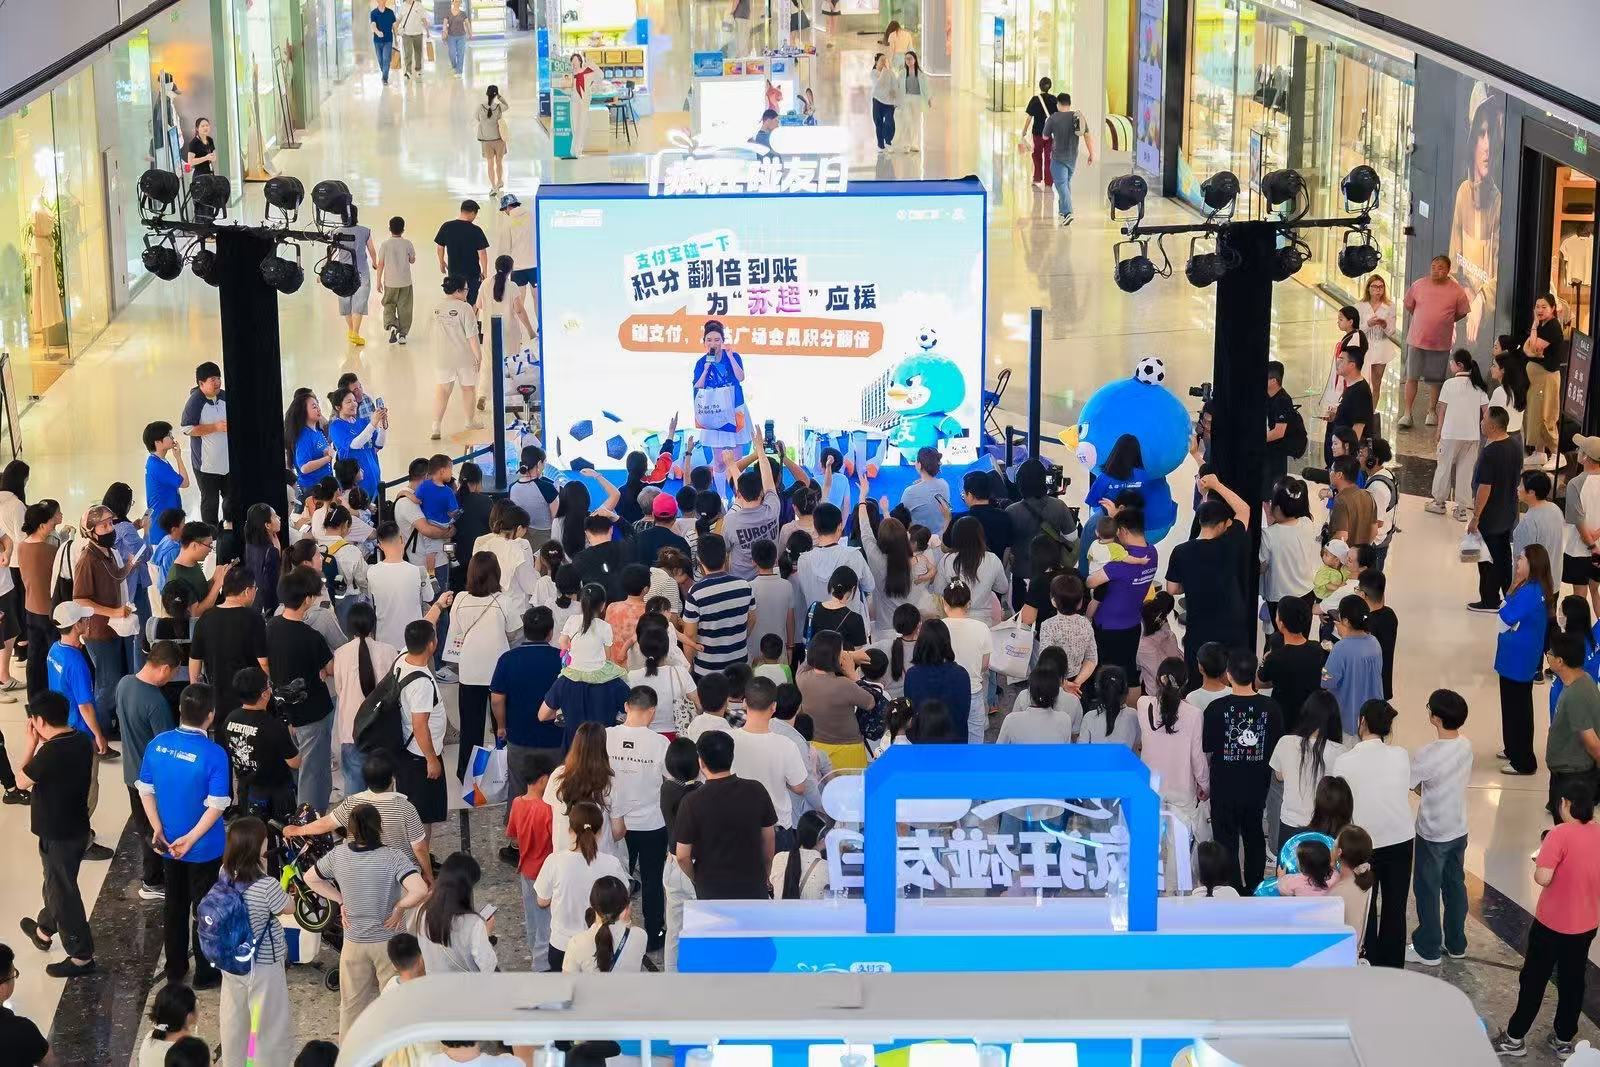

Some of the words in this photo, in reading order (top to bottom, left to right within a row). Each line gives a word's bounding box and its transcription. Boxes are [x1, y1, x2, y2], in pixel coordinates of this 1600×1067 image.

[634, 234, 731, 270] 支付宝碰一下
